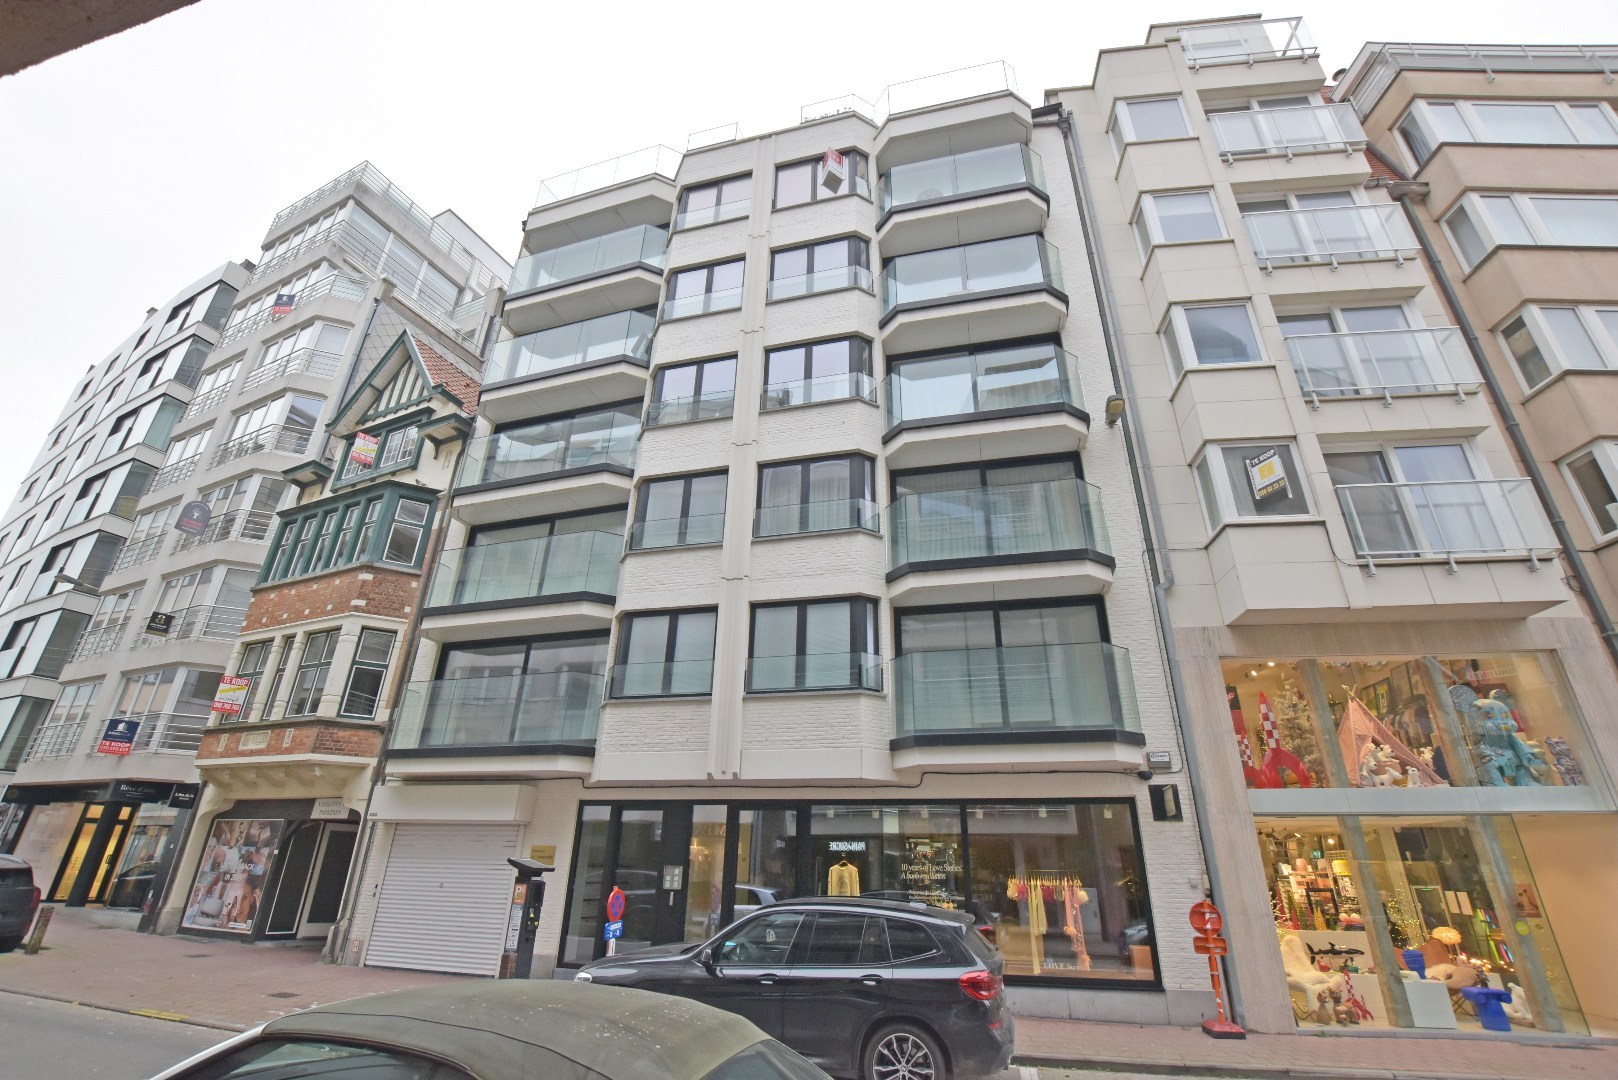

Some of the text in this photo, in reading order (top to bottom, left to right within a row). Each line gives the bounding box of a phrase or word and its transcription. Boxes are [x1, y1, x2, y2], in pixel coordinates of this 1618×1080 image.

[1251, 449, 1275, 465] TE KOOP
[223, 676, 249, 686] TE KOOP
[901, 863, 908, 871] 10
[908, 864, 923, 873] years
[930, 863, 943, 871] Love
